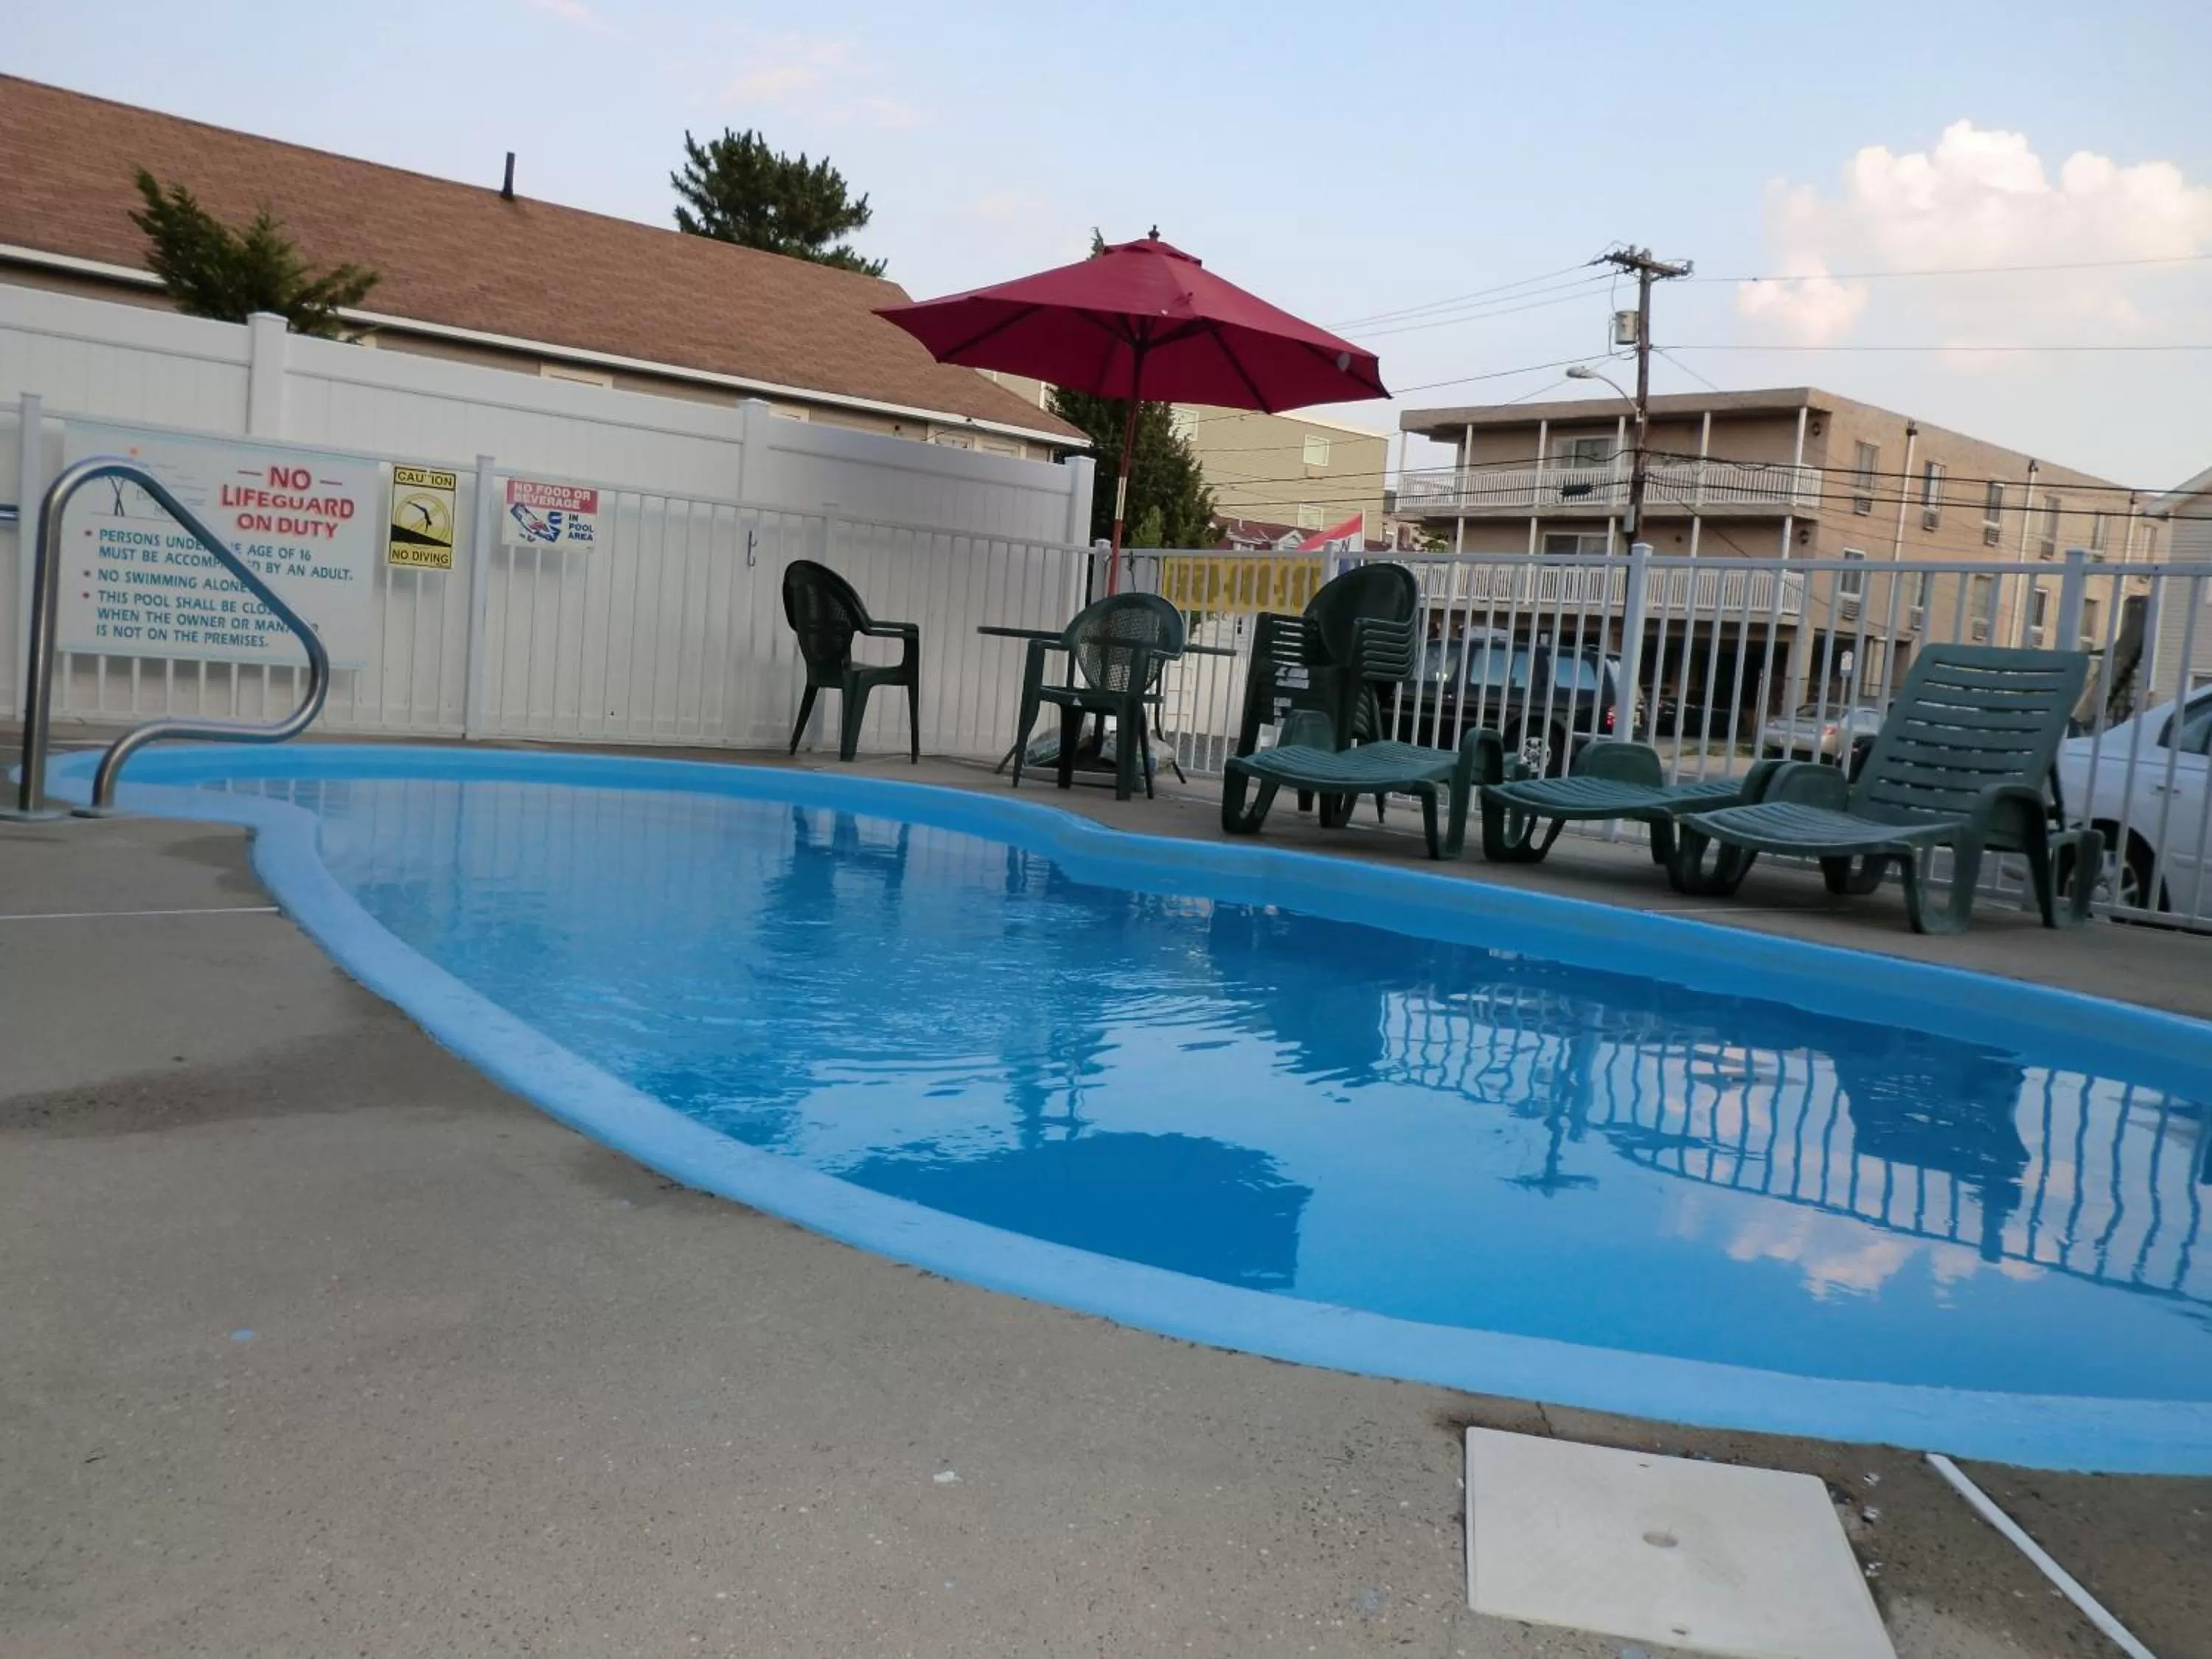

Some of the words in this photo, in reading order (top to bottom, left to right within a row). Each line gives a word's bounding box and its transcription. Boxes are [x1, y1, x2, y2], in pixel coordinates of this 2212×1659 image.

[270, 466, 312, 490] NO
[222, 484, 355, 519] LIFEGUARD
[514, 482, 533, 493] NO
[536, 485, 571, 498] FOOD
[574, 490, 591, 501] OR
[514, 493, 581, 509] BEVERAGE
[237, 512, 272, 532] ON
[277, 517, 338, 538] DUTY
[568, 513, 579, 522] IN
[568, 523, 594, 533] POOL
[99, 528, 161, 546] PERSONS
[166, 535, 210, 552] UNDE
[247, 543, 274, 558] AGE
[278, 547, 296, 561] OF
[299, 549, 312, 561] 16
[567, 532, 594, 542] AREA
[98, 546, 136, 561] MUST
[142, 551, 159, 563] BE
[265, 562, 282, 574] BY
[286, 563, 305, 576] AN
[310, 566, 354, 581] ADULT.
[392, 548, 409, 560] NO
[412, 551, 449, 564] DIVING
[97, 568, 119, 582] NO
[125, 570, 198, 589] SWIMMING
[97, 589, 129, 605] THIS
[133, 592, 170, 608] POOL
[175, 596, 218, 612] SHALL
[221, 600, 237, 613] BE
[97, 606, 140, 622] WHEN
[145, 611, 172, 625] THE
[176, 613, 226, 627] OWNER
[231, 616, 250, 630] OR
[96, 623, 107, 637] IS
[113, 625, 142, 639] NOT
[147, 627, 168, 641] ON
[173, 629, 198, 643] THE
[204, 632, 270, 647] PREMISES.
